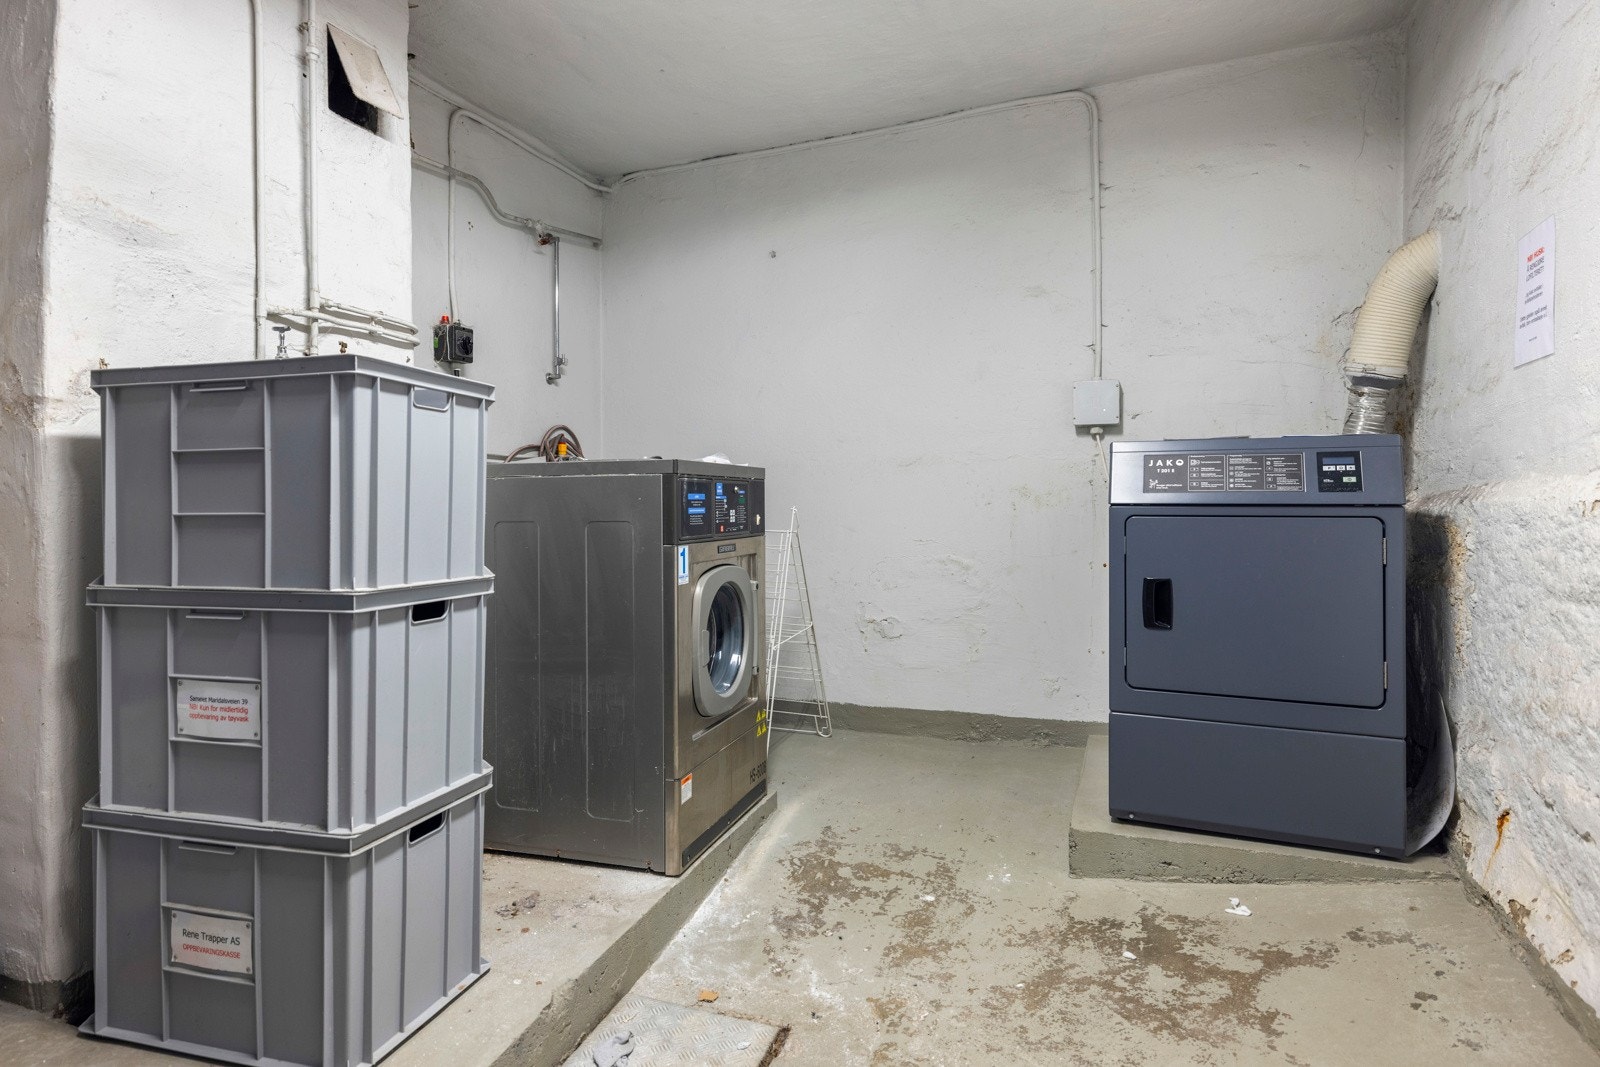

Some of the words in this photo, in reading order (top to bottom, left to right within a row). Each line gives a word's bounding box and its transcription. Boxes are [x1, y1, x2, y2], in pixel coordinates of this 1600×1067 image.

[680, 548, 685, 574] 1
[189, 713, 219, 722] oppbevaring
[220, 706, 248, 714] midlertidig
[182, 928, 200, 940] Rene
[201, 932, 228, 944] Trapper
[230, 936, 240, 946] AS
[182, 943, 241, 958] OPPBEVARINGSKASSE
